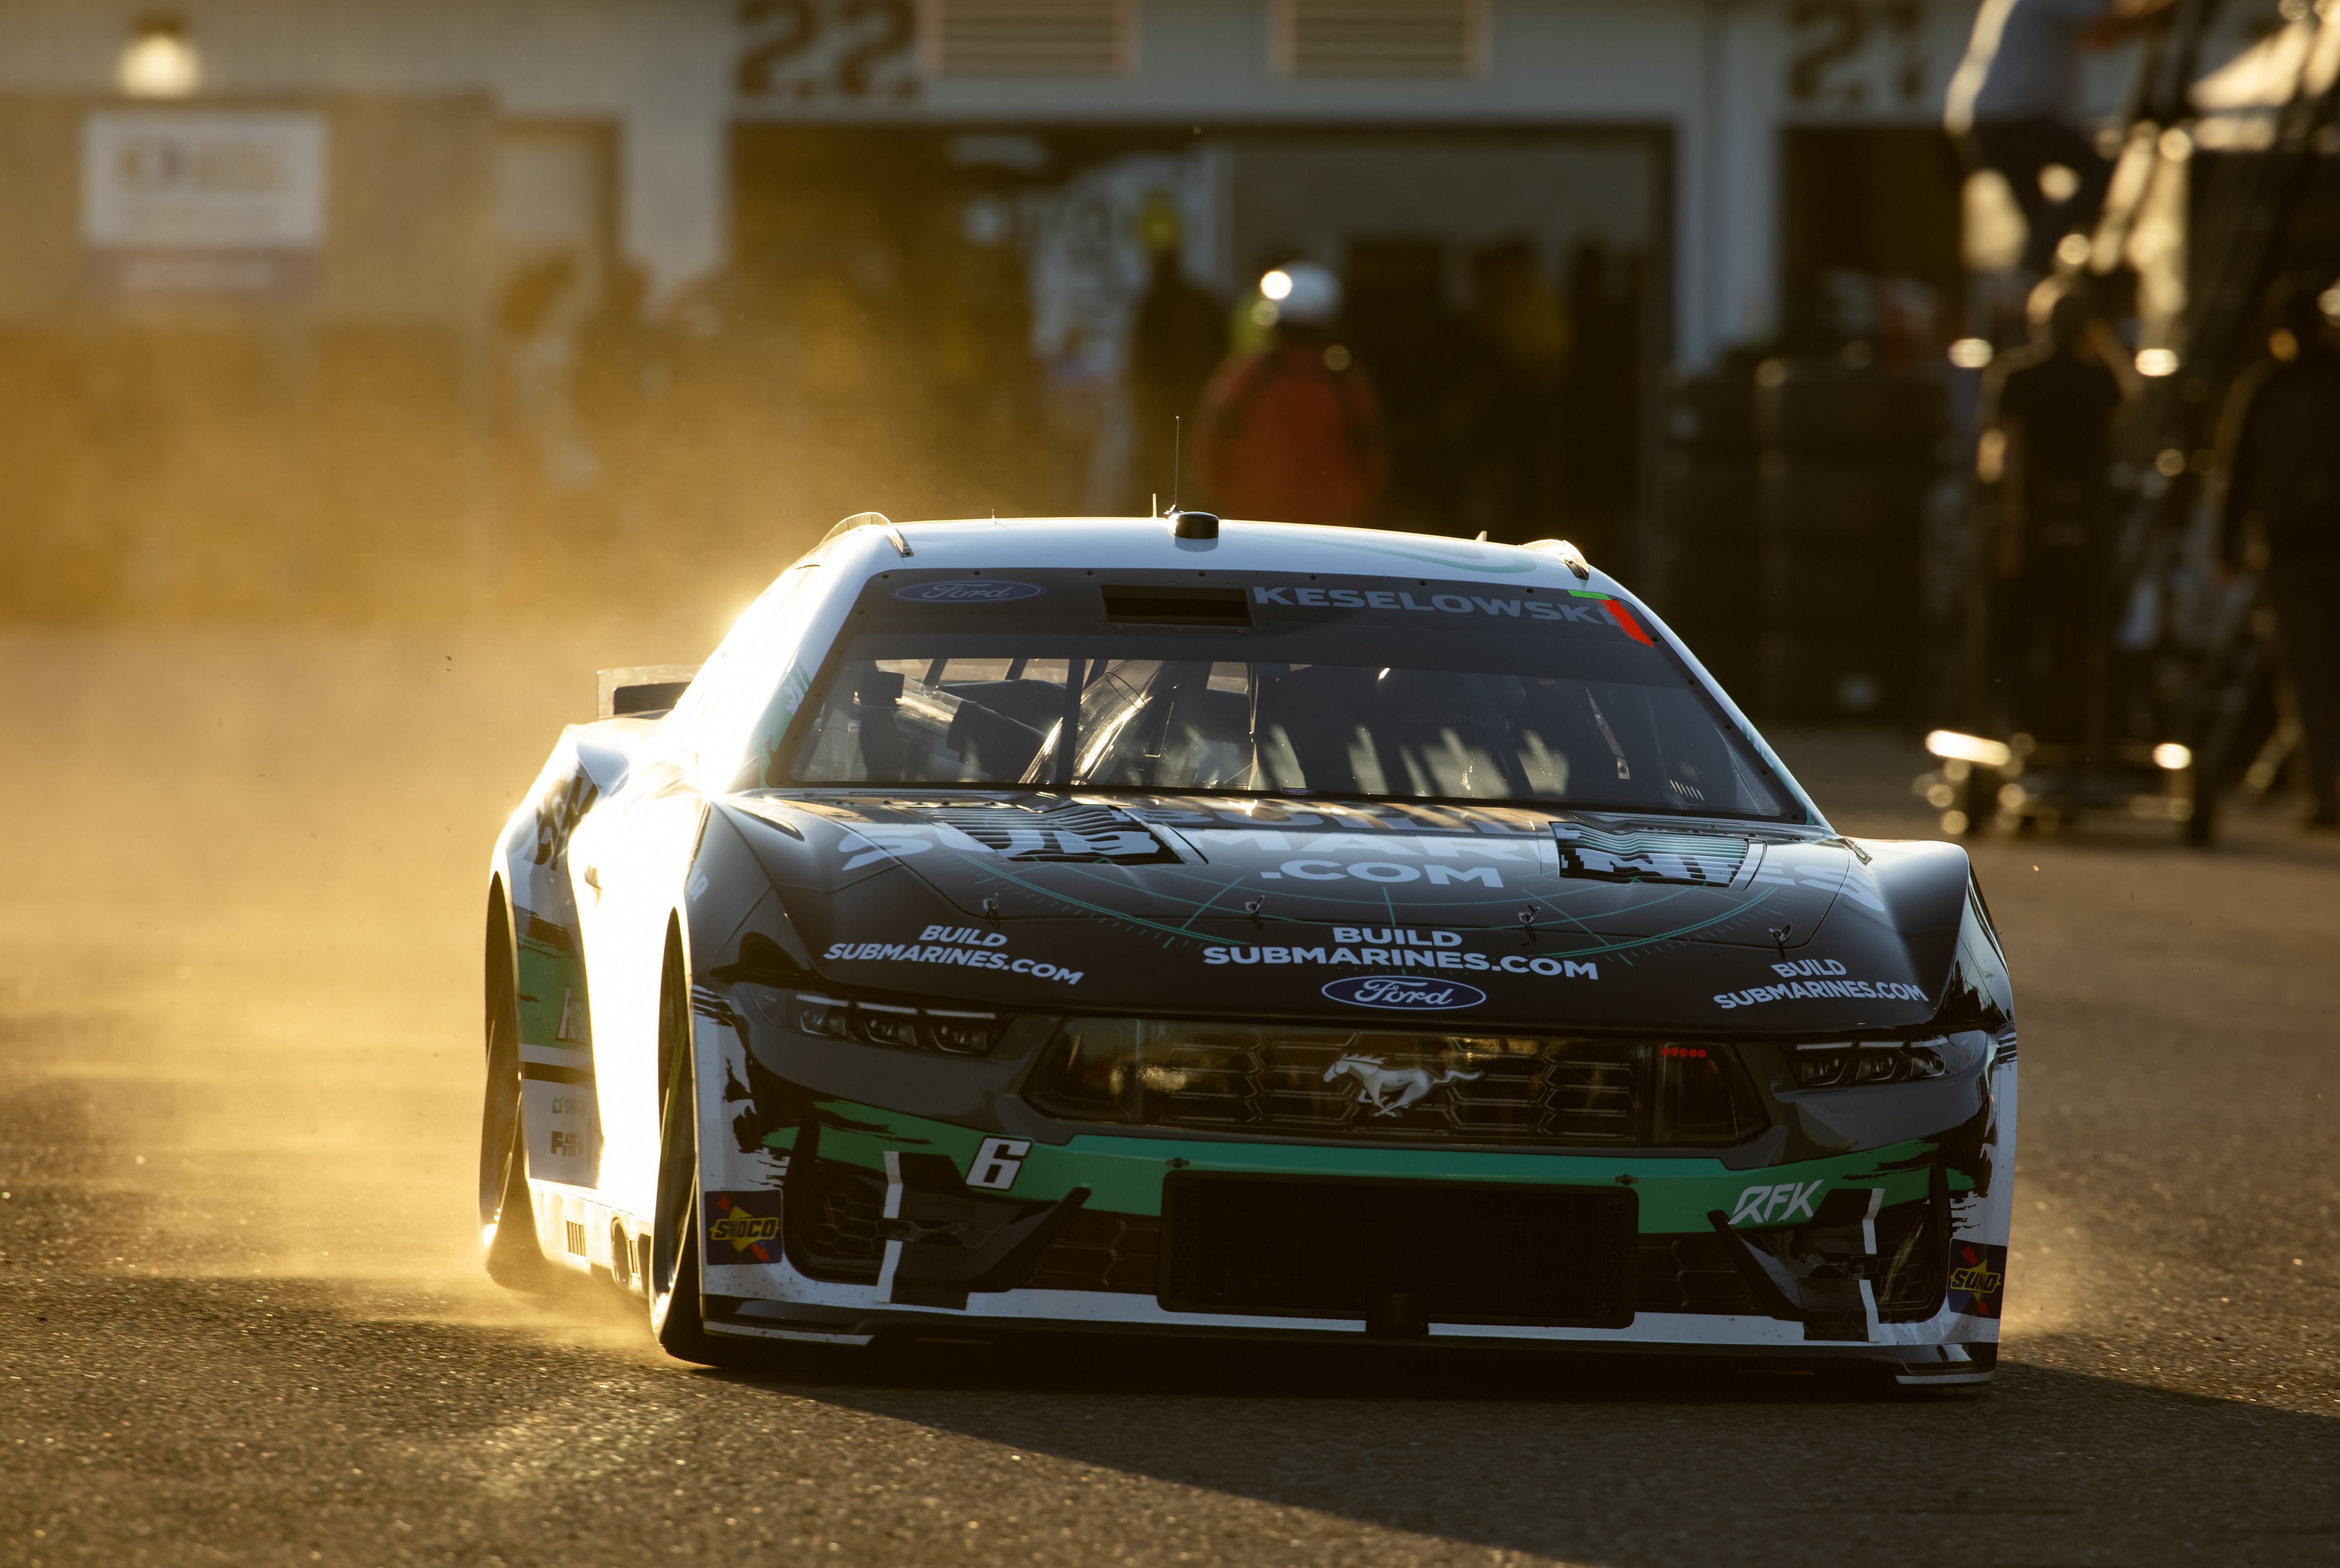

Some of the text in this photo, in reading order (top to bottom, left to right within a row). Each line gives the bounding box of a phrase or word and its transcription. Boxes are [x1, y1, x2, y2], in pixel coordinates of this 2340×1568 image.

[923, 583, 1012, 599] Ford
[1261, 859, 1504, 888] .COM
[919, 925, 1007, 947] BUILD
[1333, 927, 1462, 947] BUILD
[823, 943, 1084, 985] SUBMARINES.COM
[1203, 946, 1598, 980] SUBMARINES.COM
[1770, 959, 1847, 978] BUILD
[1354, 980, 1453, 1005] Ford
[1713, 980, 1929, 1009] SUBMARINES.COM
[967, 1138, 1031, 1190] 6
[1729, 1179, 1823, 1225] RFK
